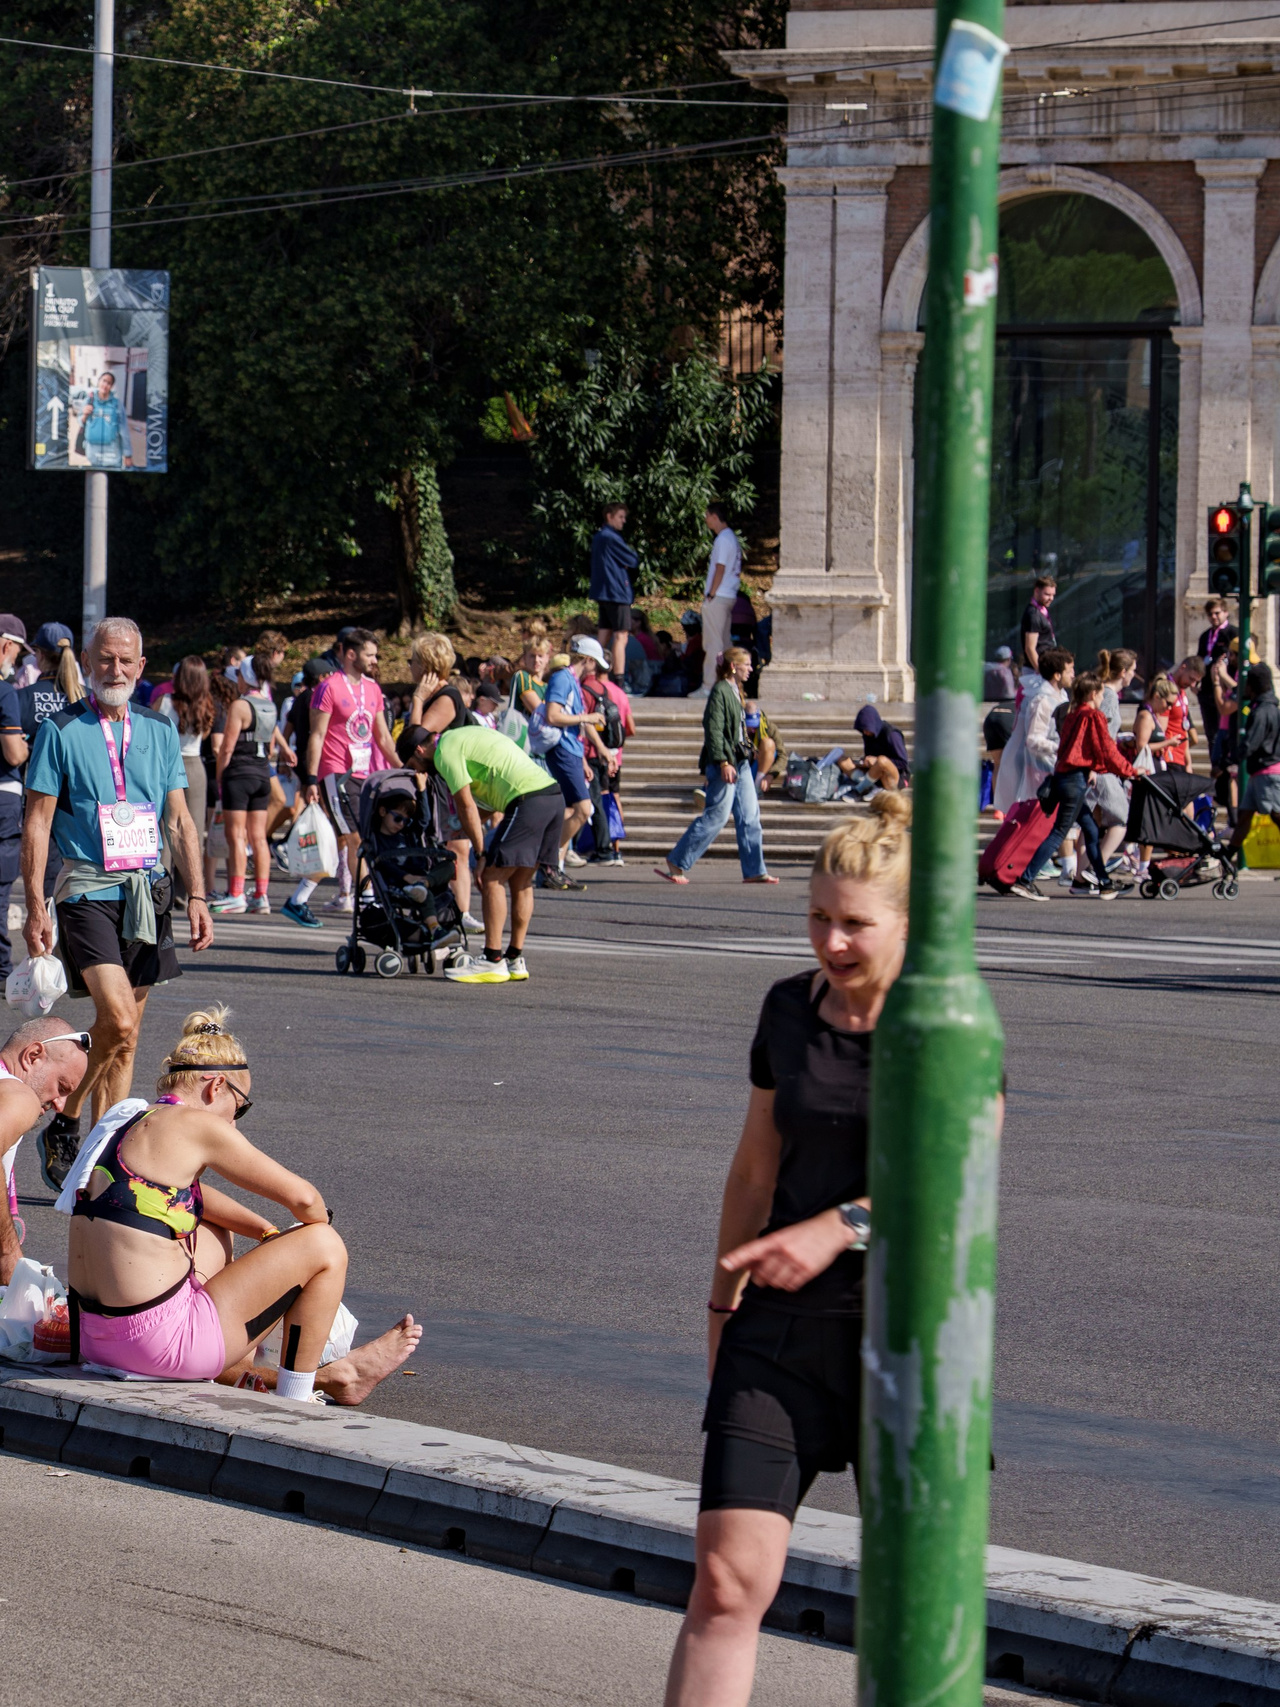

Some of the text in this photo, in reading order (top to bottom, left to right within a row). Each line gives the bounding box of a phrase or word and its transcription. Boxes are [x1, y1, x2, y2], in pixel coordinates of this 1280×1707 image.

[45, 282, 55, 297] 1
[44, 297, 78, 306] MINUTO
[148, 400, 163, 460] ROMA
[34, 692, 68, 703] POLIZ
[34, 703, 64, 713] ROM
[117, 828, 148, 848] 20081
